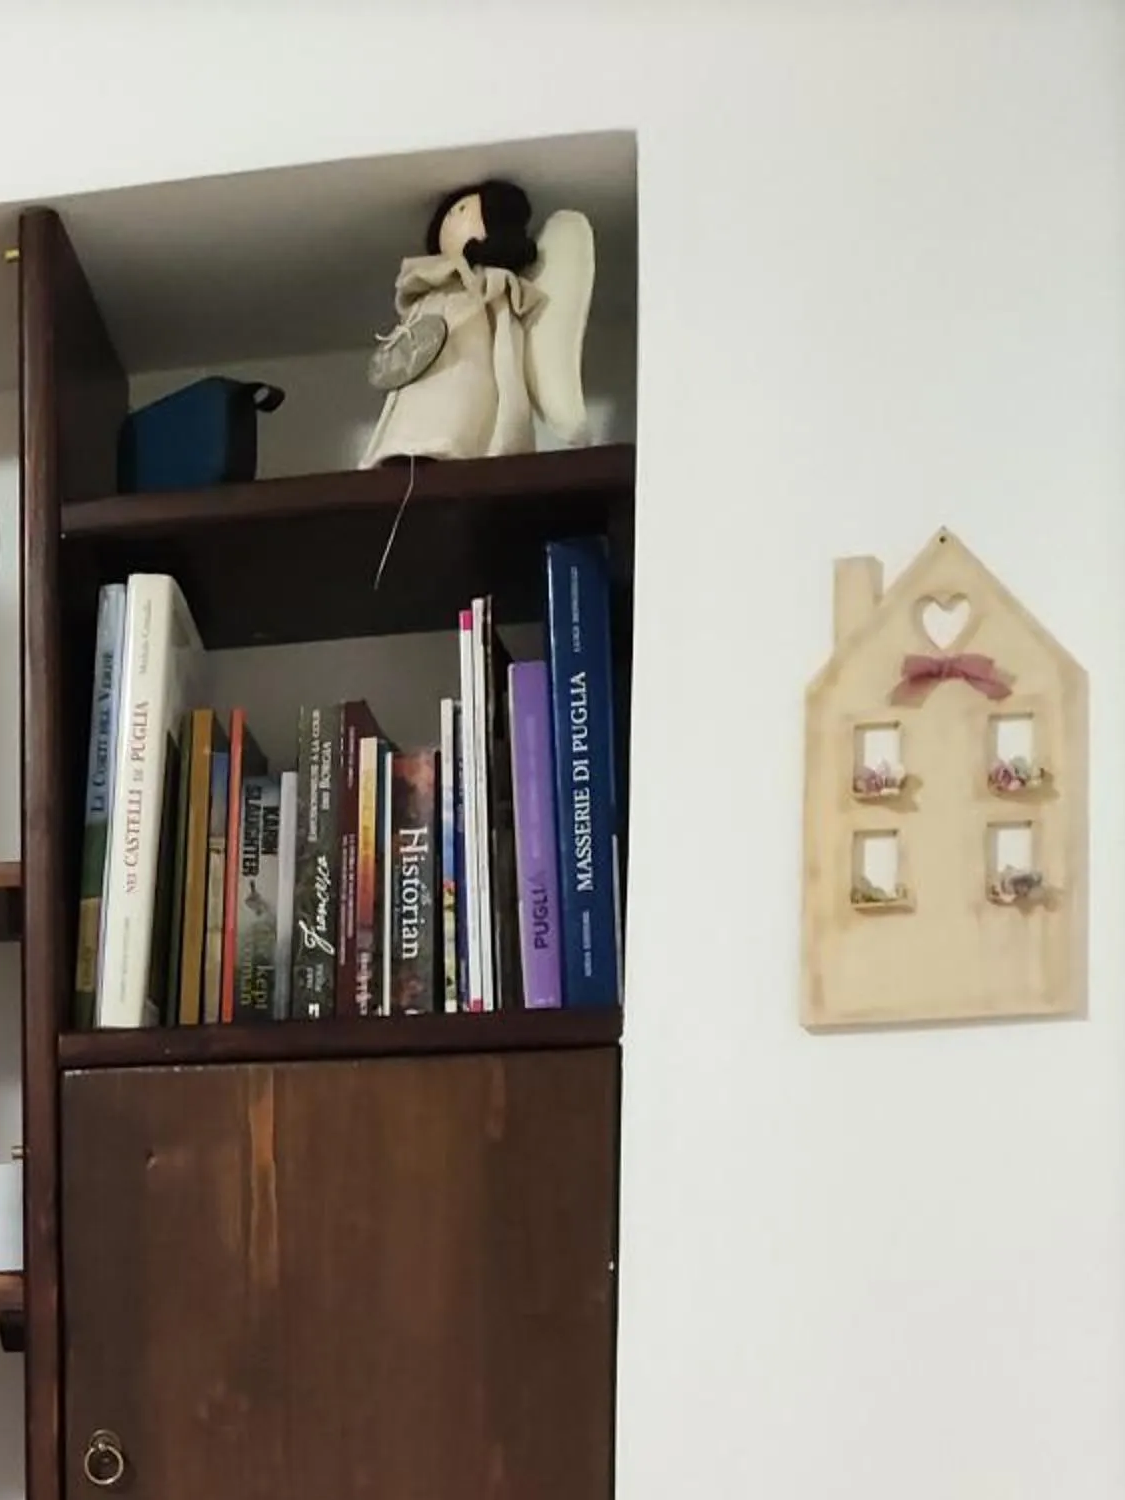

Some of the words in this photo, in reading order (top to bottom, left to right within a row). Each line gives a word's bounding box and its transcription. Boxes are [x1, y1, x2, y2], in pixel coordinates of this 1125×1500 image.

[129, 701, 149, 762] PUGLIA
[569, 670, 590, 752] PUGLIA
[571, 756, 591, 782] DI
[123, 789, 142, 867] CASTELLI
[242, 785, 261, 877] SLAUGHTER
[261, 806, 279, 856] KARIN
[571, 786, 595, 892] MASSERIE
[125, 872, 137, 894] NEI
[397, 826, 430, 960] Historian
[528, 872, 551, 950] PUGLIA
[251, 965, 275, 1010] kept
